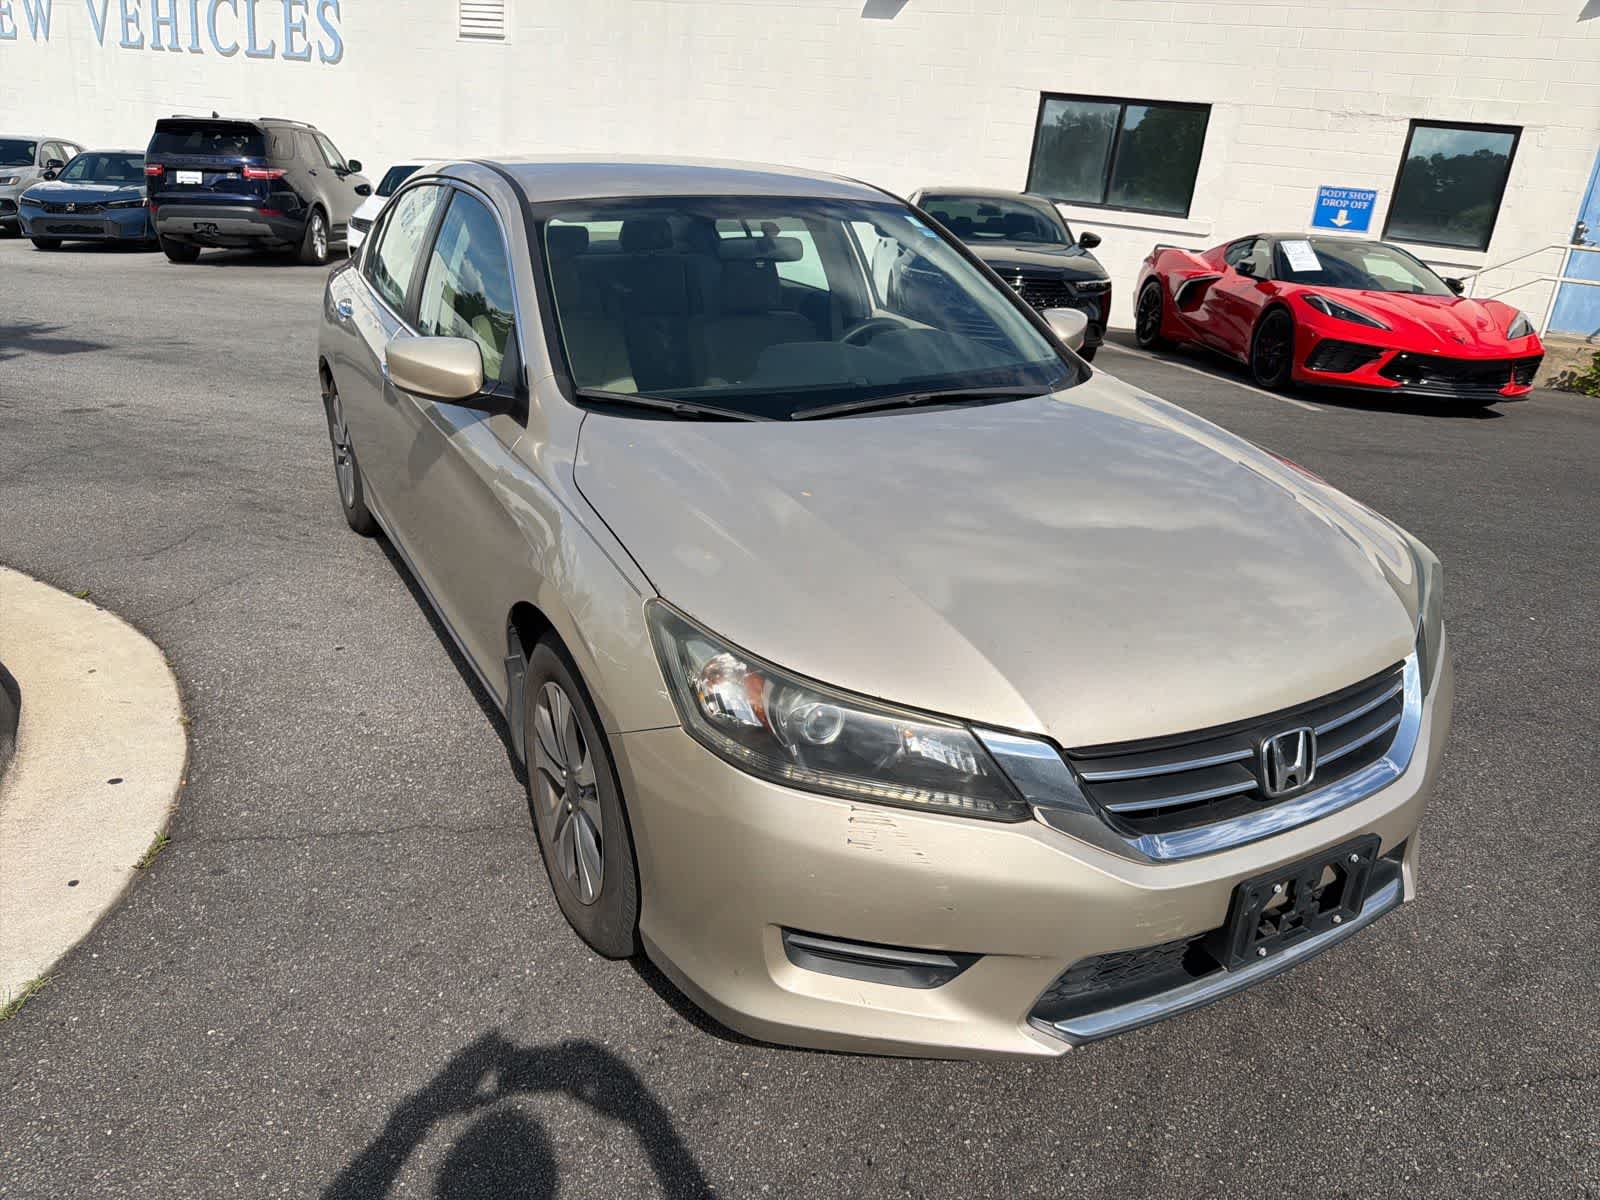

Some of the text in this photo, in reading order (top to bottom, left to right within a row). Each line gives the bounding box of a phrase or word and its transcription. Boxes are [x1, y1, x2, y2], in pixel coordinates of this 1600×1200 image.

[86, 0, 344, 65] VEHICLES
[1320, 189, 1375, 201] BODY SHOP
[1321, 198, 1369, 209] DROP OFF
